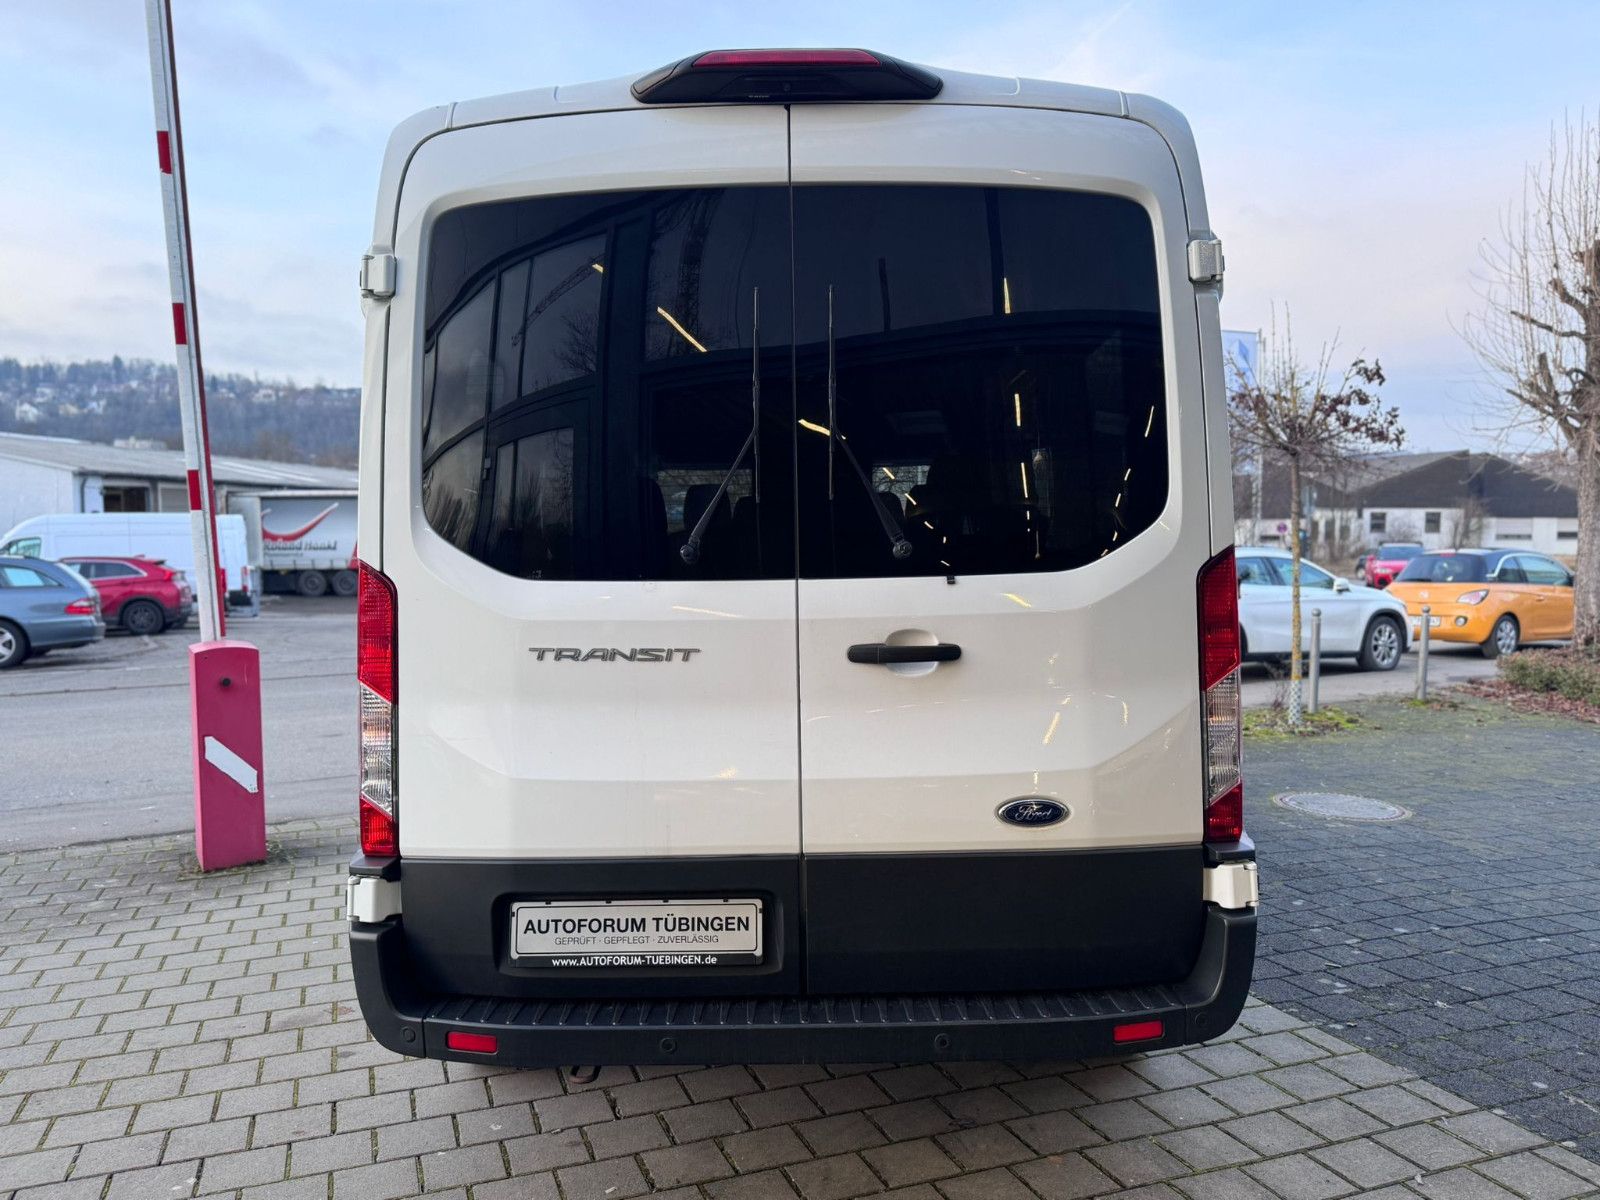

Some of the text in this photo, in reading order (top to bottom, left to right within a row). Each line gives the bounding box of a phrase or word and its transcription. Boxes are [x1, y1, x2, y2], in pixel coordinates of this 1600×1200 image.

[528, 647, 702, 662] TRANSIT
[523, 913, 750, 935] AUTOFORUM TÜBINGEN
[555, 933, 719, 945] GEPRÜFT GEPFLEGT ZUVERLÄSSIG
[551, 954, 718, 967] www.AUTOFORUM-TUEBINGEN.de
